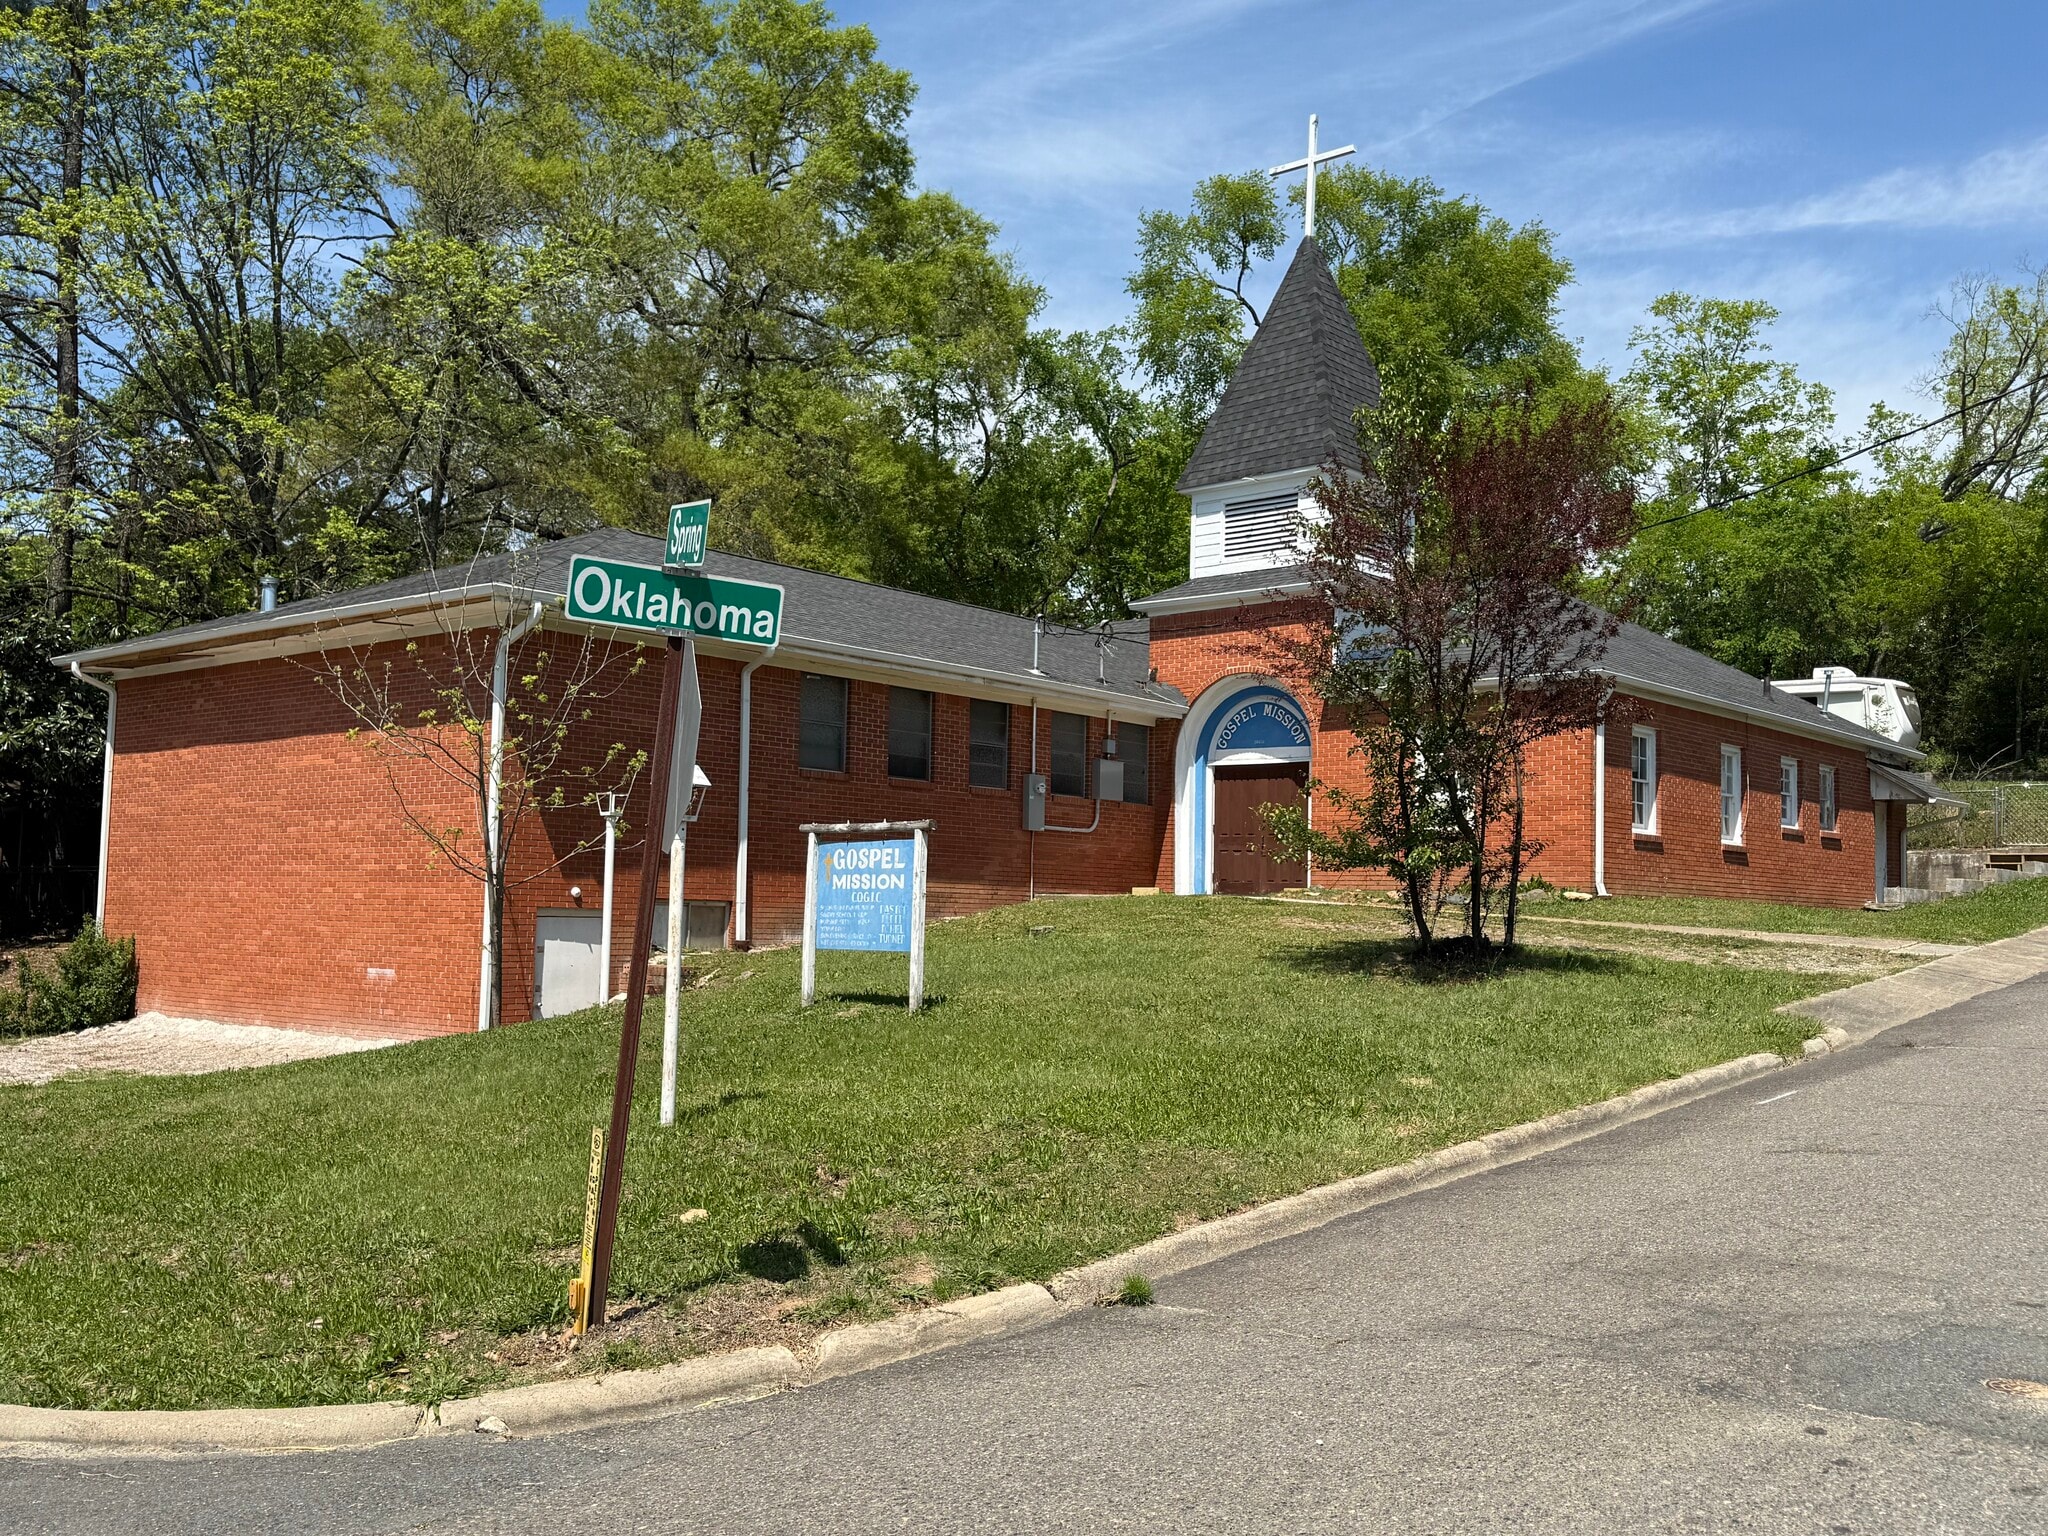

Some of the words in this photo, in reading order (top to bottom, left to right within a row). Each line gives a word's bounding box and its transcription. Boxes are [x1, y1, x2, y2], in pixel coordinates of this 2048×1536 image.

[671, 510, 703, 561] Spring
[574, 566, 774, 639] Oklahoma
[1218, 707, 1256, 748] GOSPEL
[1263, 704, 1306, 743] MISSION
[833, 848, 906, 870] GOSPEL
[832, 873, 905, 890] MISSION
